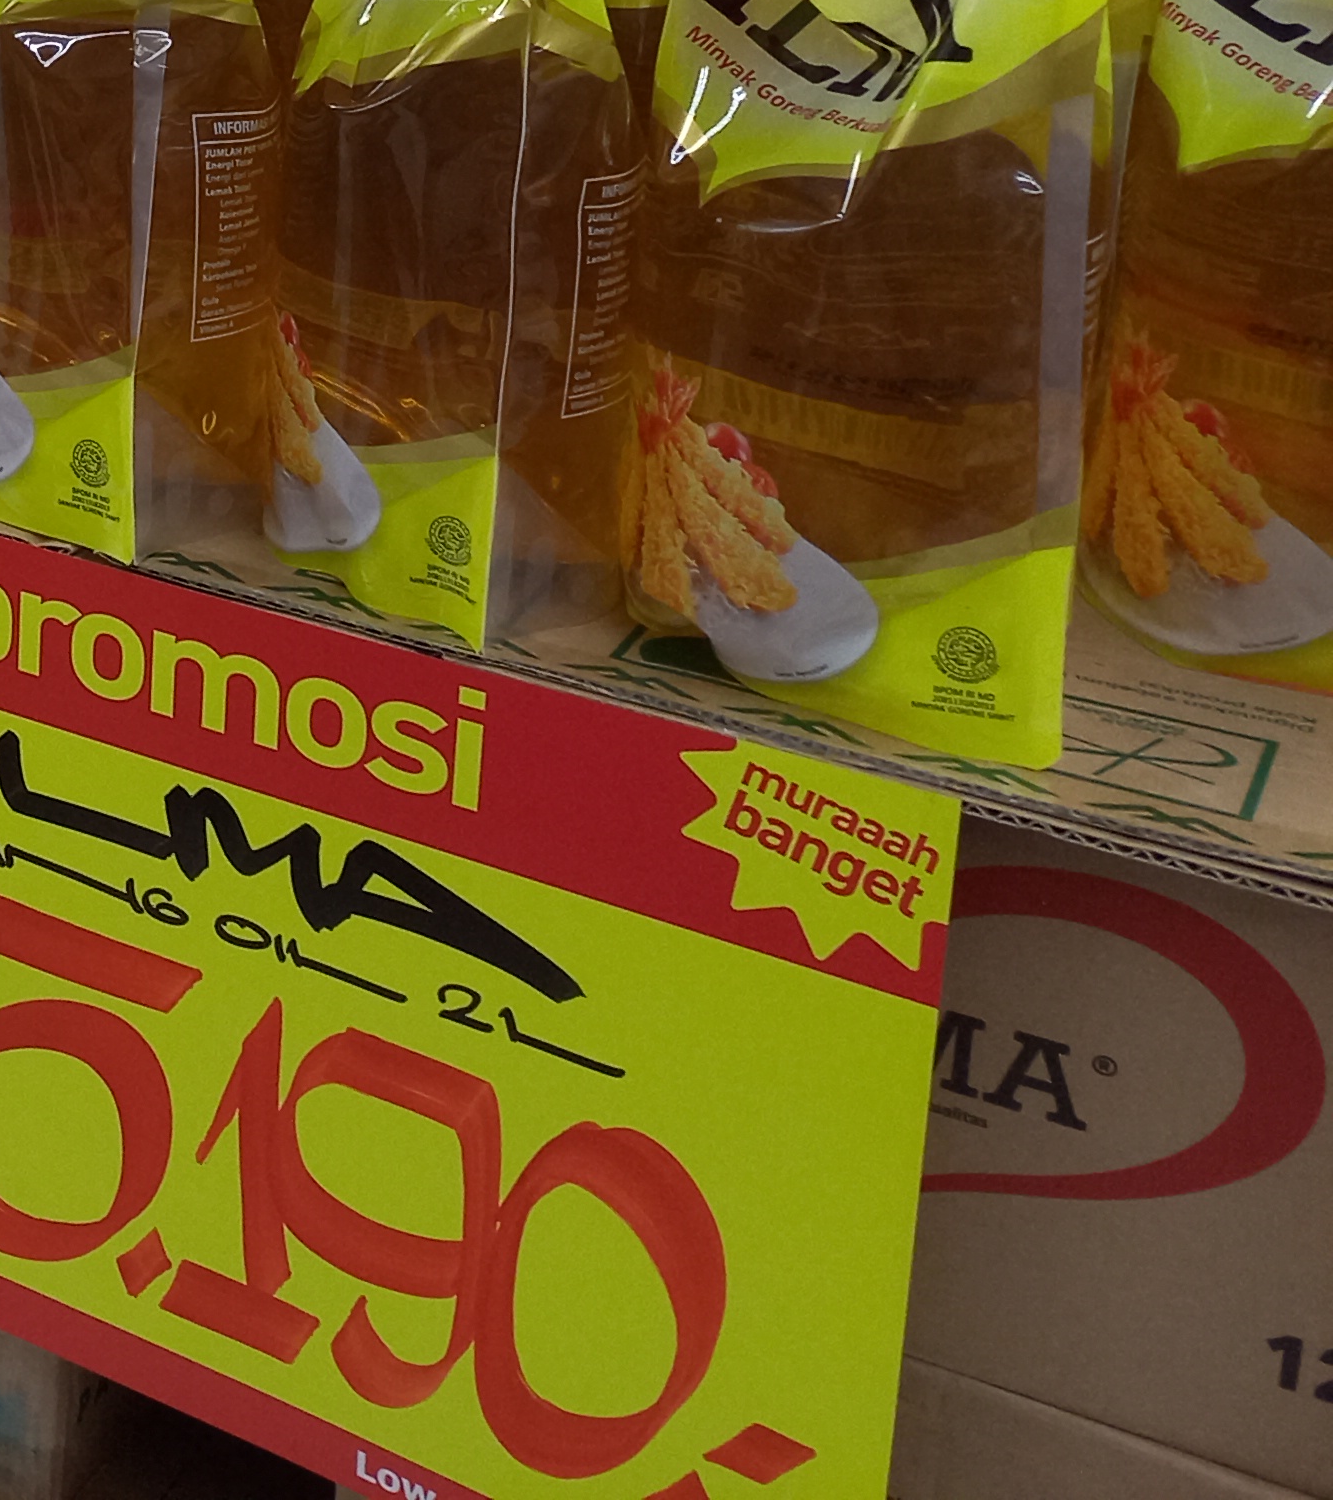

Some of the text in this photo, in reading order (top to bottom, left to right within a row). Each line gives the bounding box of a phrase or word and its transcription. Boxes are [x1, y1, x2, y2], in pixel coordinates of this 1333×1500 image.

[684, 23, 819, 120] Minyak Goreng
[1220, 41, 1290, 93] Goreng
[723, 791, 925, 921] banget
[740, 758, 942, 878] muraaah
[355, 1450, 436, 1500] Low
